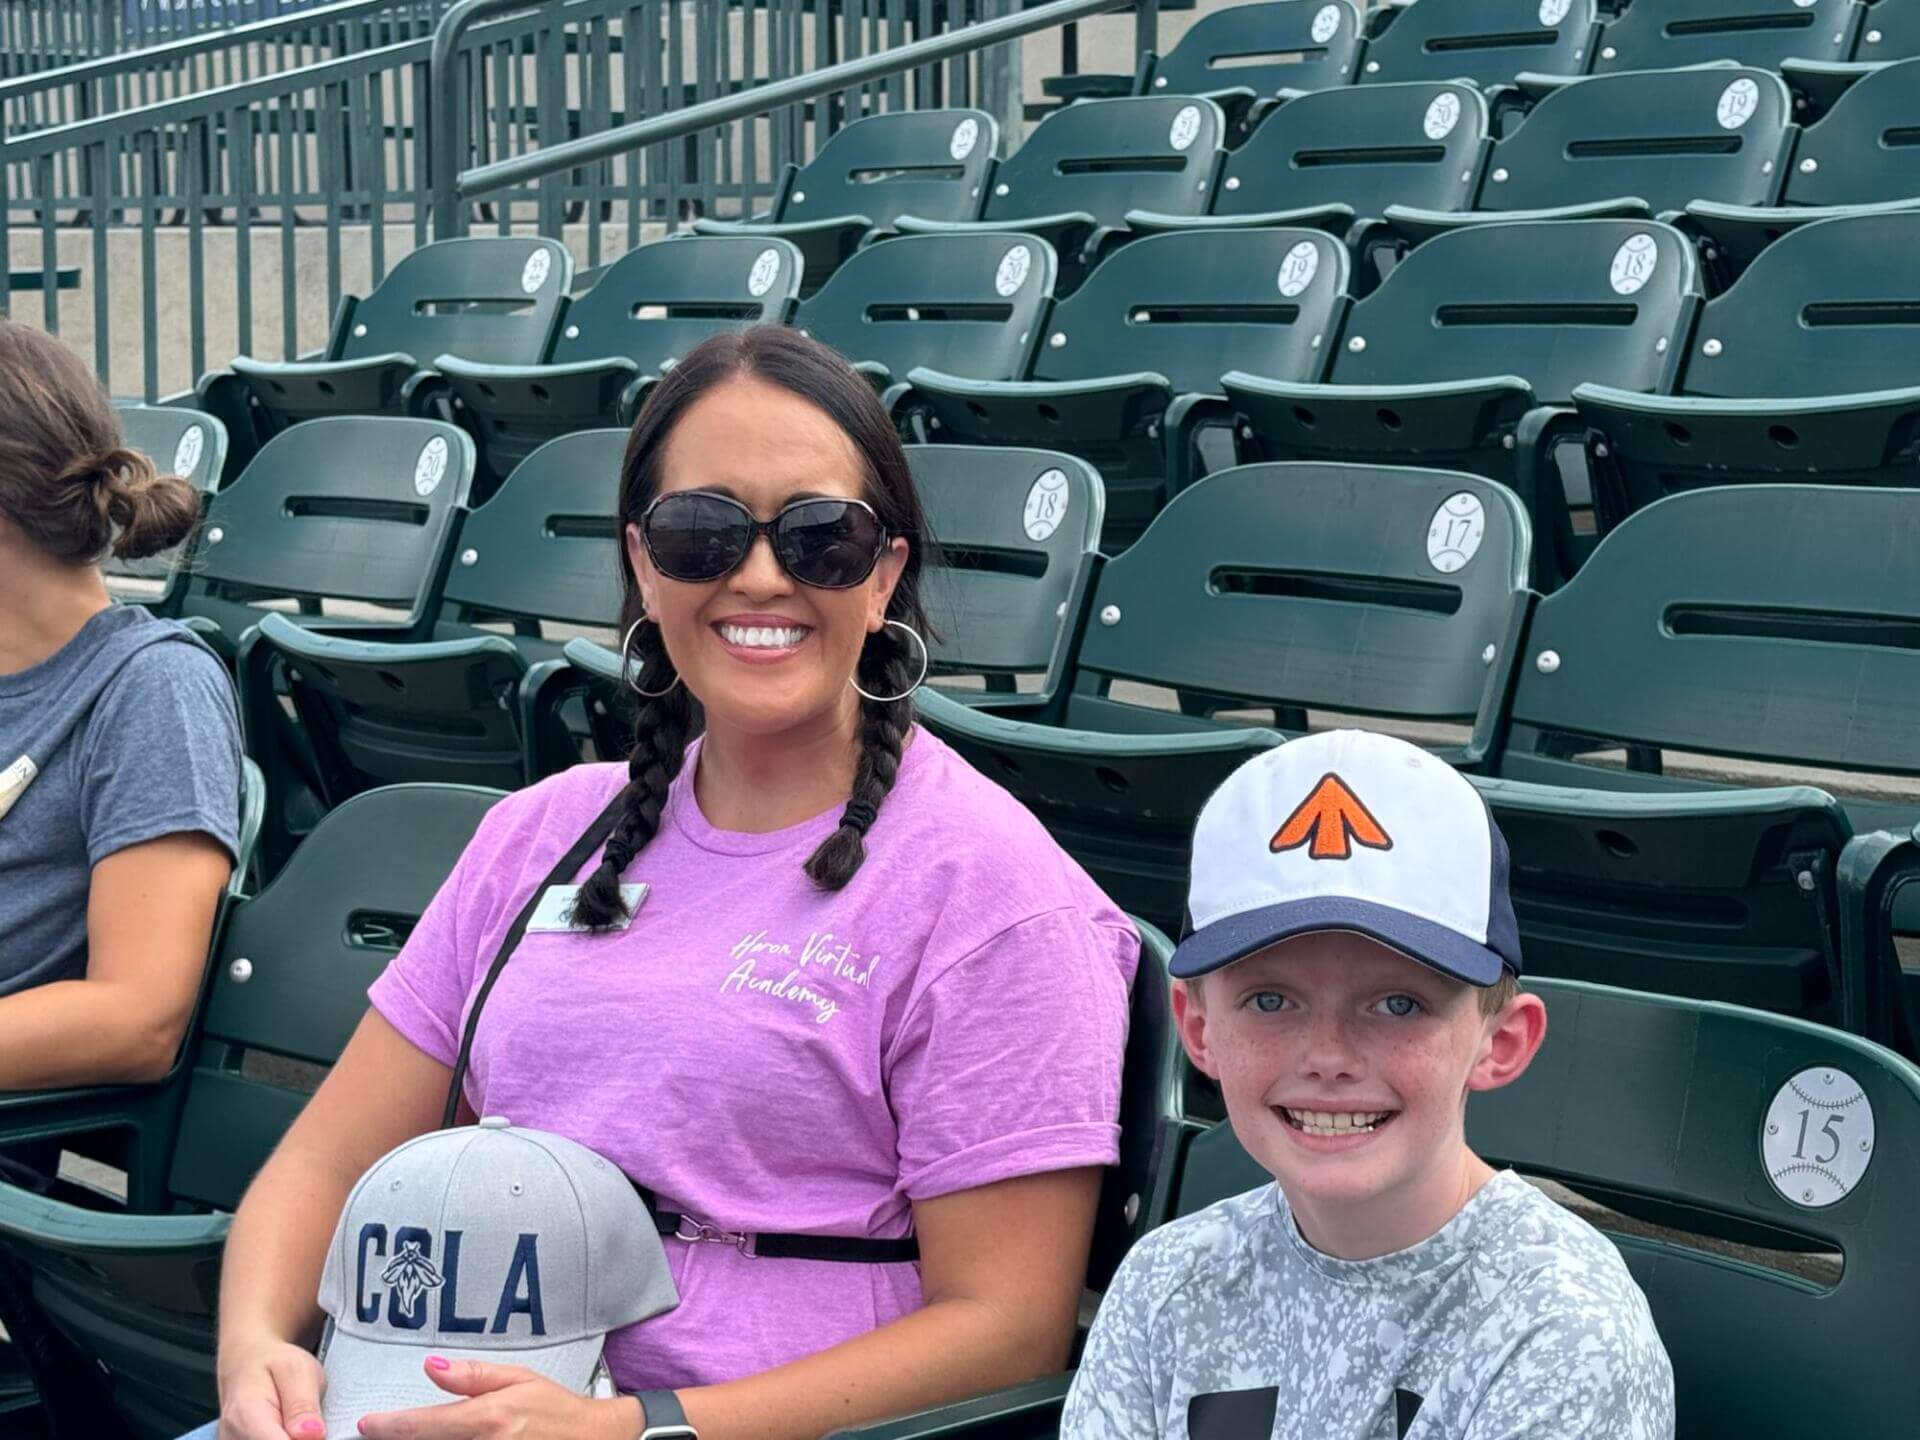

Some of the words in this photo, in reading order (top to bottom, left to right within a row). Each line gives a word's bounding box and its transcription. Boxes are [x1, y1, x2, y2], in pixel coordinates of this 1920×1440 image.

[1730, 94, 1748, 114] 19
[1289, 259, 1309, 281] 19
[1624, 254, 1647, 276] 18
[422, 455, 440, 478] 20
[1035, 493, 1058, 519] 18
[1444, 519, 1472, 548] 17
[1790, 1109, 1847, 1164] 15
[356, 1223, 546, 1336] COLA
